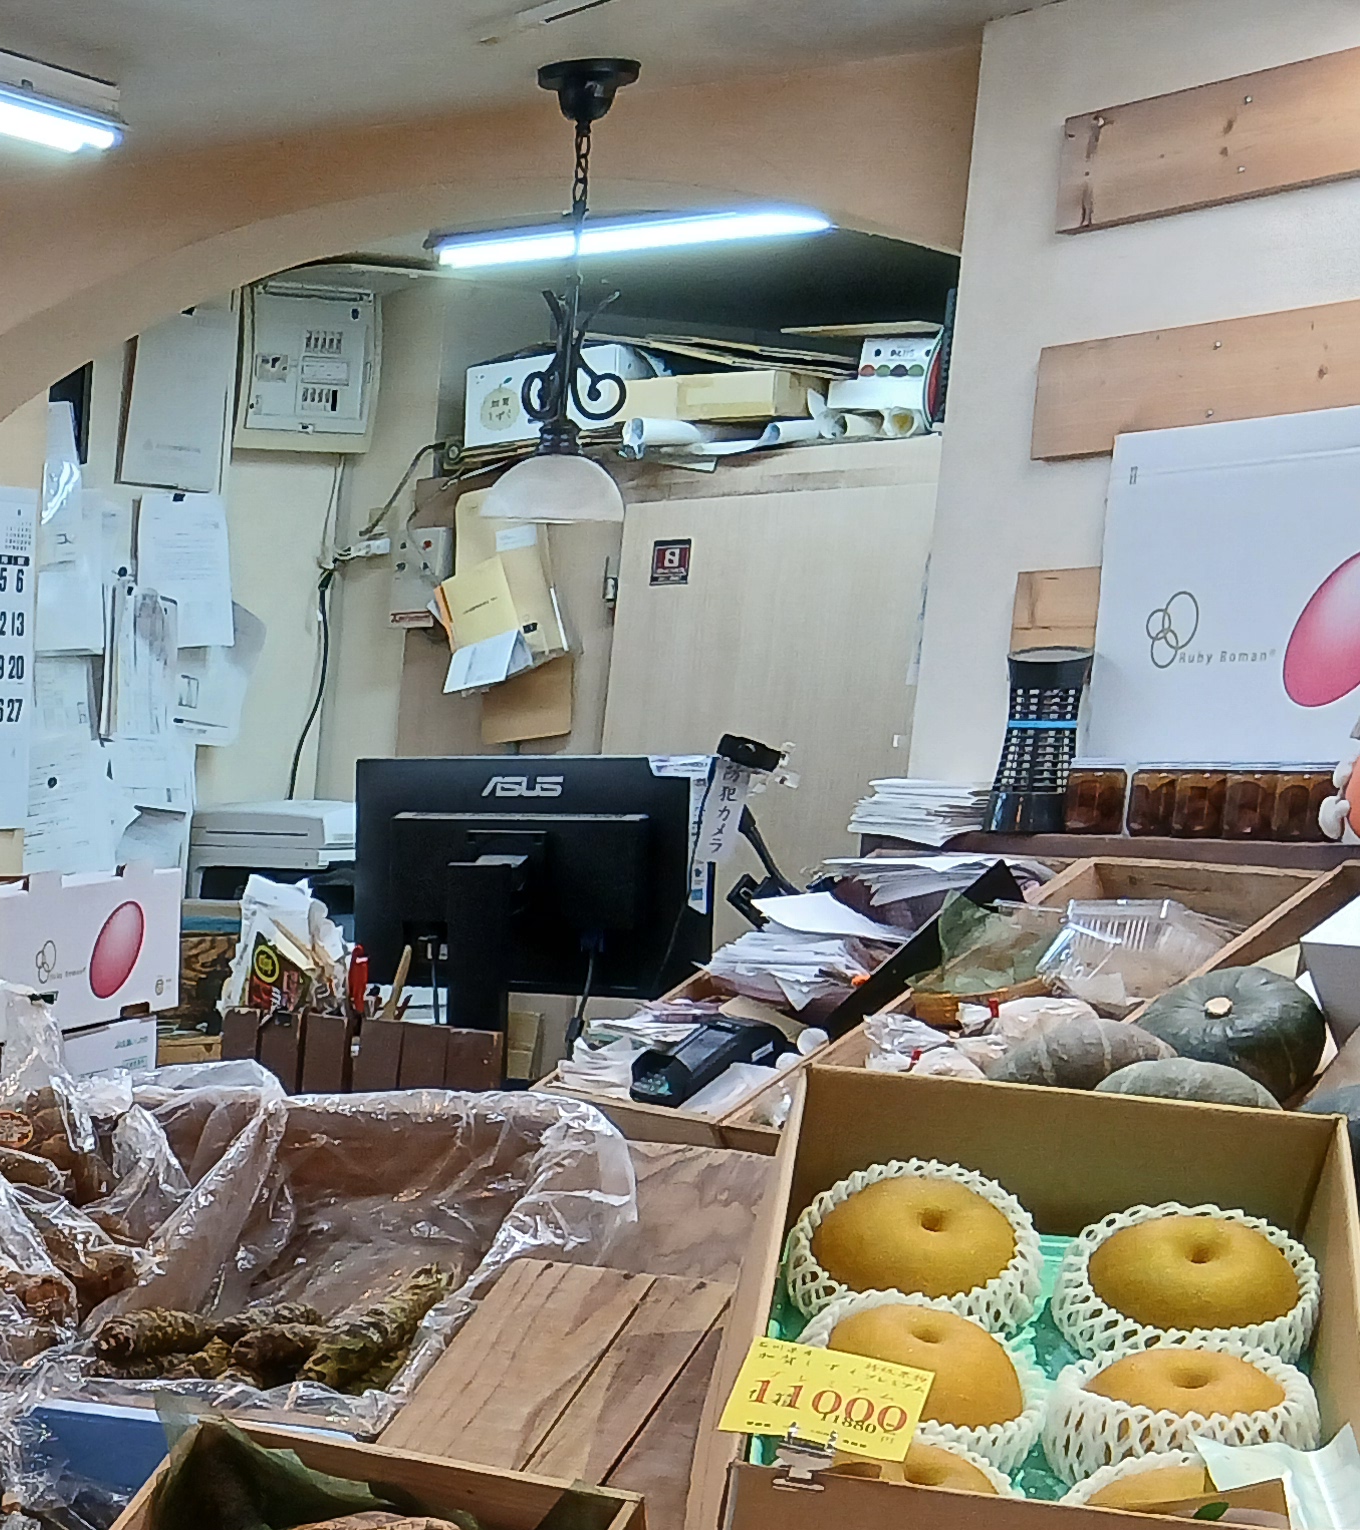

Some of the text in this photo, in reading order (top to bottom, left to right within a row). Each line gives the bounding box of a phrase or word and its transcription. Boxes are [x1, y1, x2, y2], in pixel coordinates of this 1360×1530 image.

[0, 568, 8, 592] 5
[16, 569, 24, 593] 6
[11, 612, 25, 637] 13
[8, 655, 25, 680] 20
[1178, 652, 1213, 665] Ruby
[7, 698, 23, 722] 27
[482, 775, 564, 797] ASUS
[709, 763, 742, 853] 防犯カメラ
